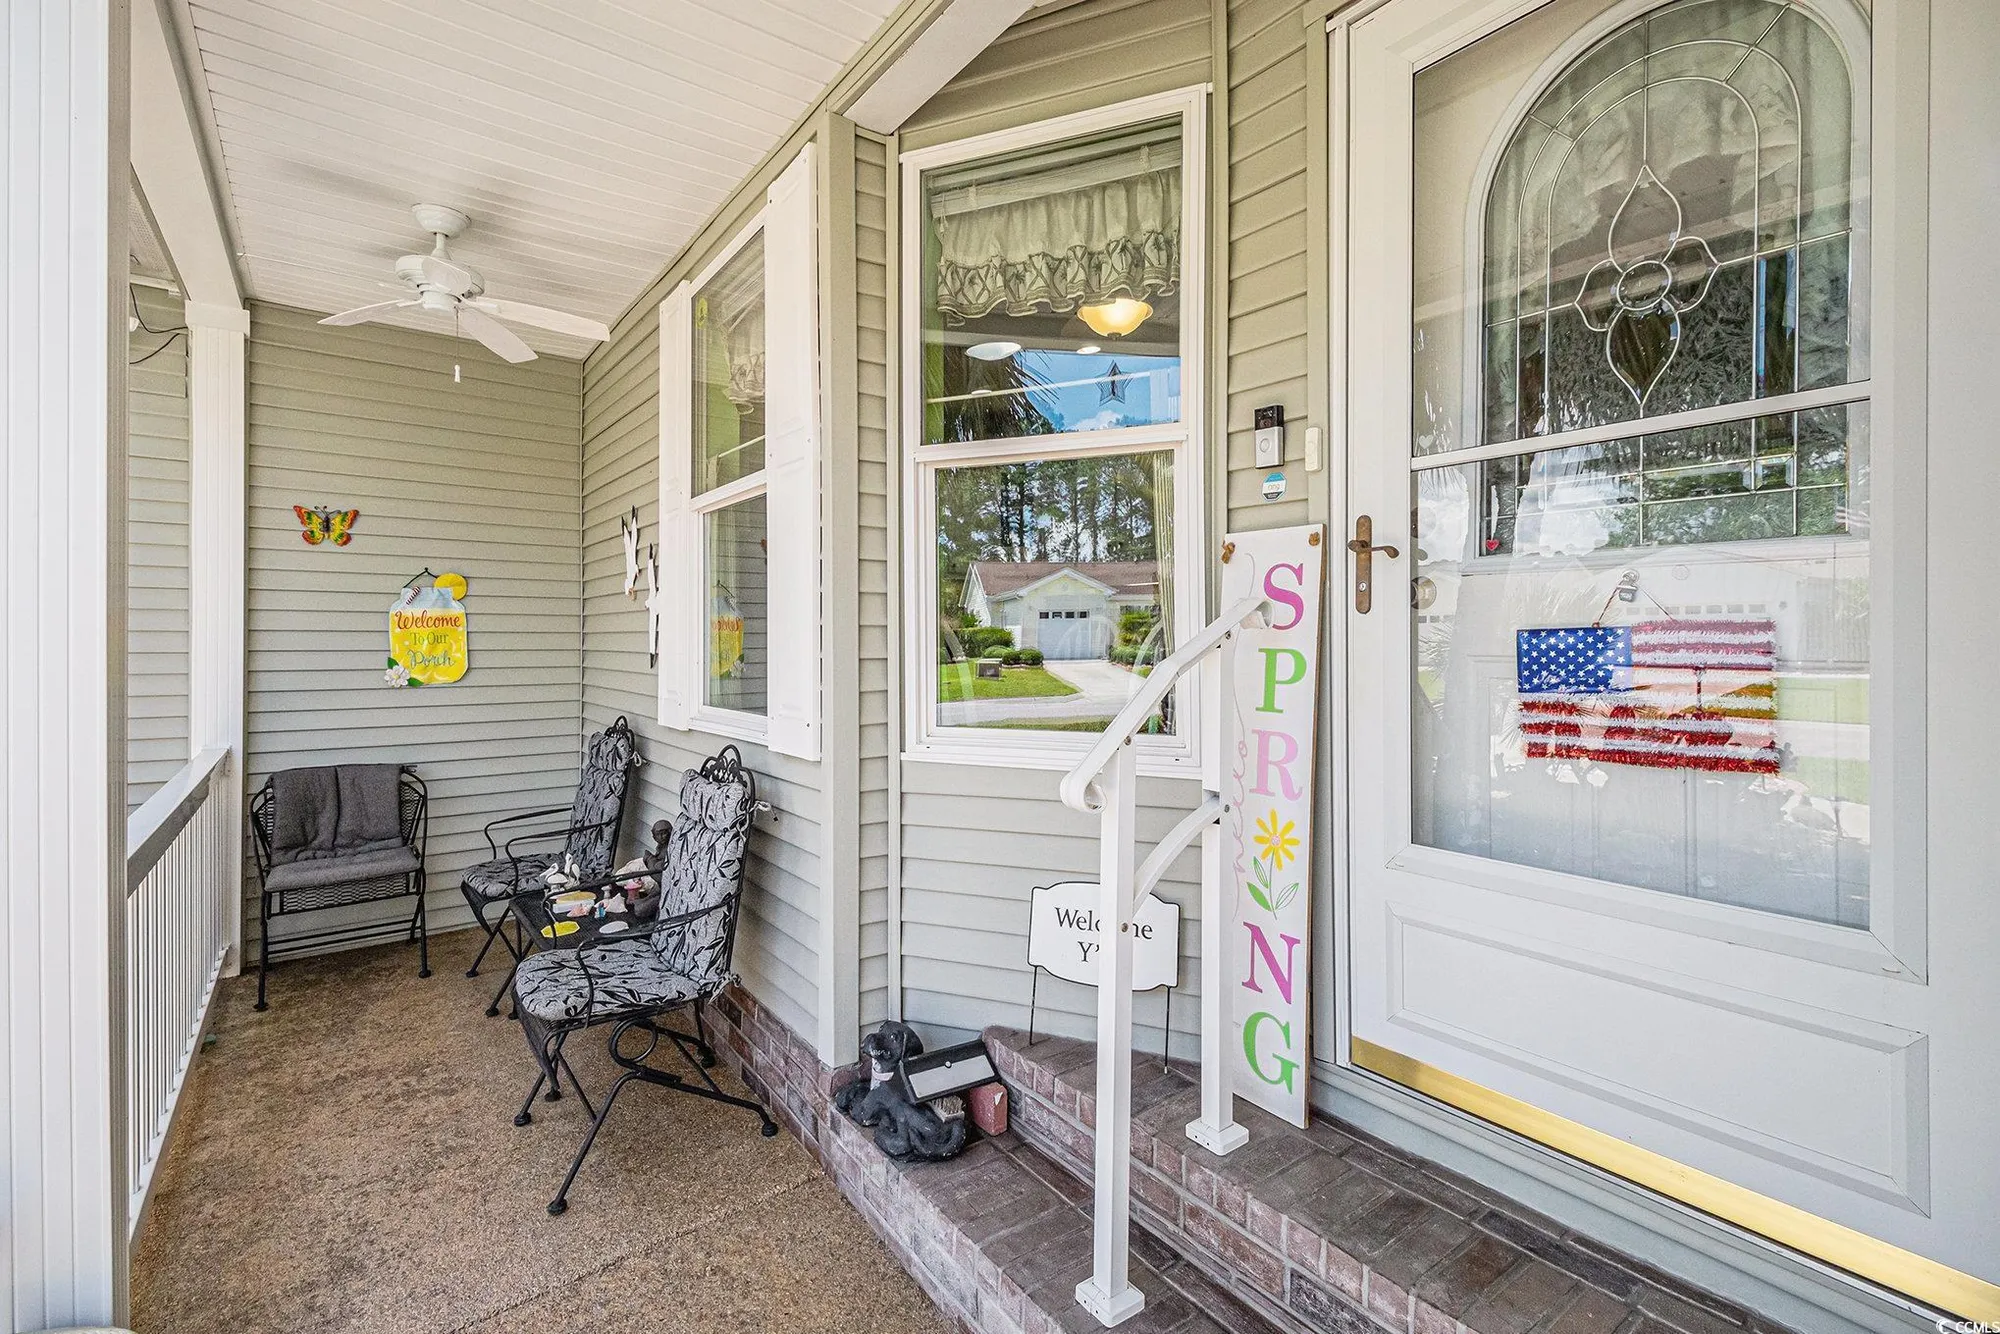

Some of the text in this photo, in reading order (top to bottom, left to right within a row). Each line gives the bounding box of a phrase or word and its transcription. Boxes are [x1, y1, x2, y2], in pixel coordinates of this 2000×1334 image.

[395, 609, 461, 630] Welcome
[410, 631, 449, 646] To Our
[407, 649, 455, 669] Porch
